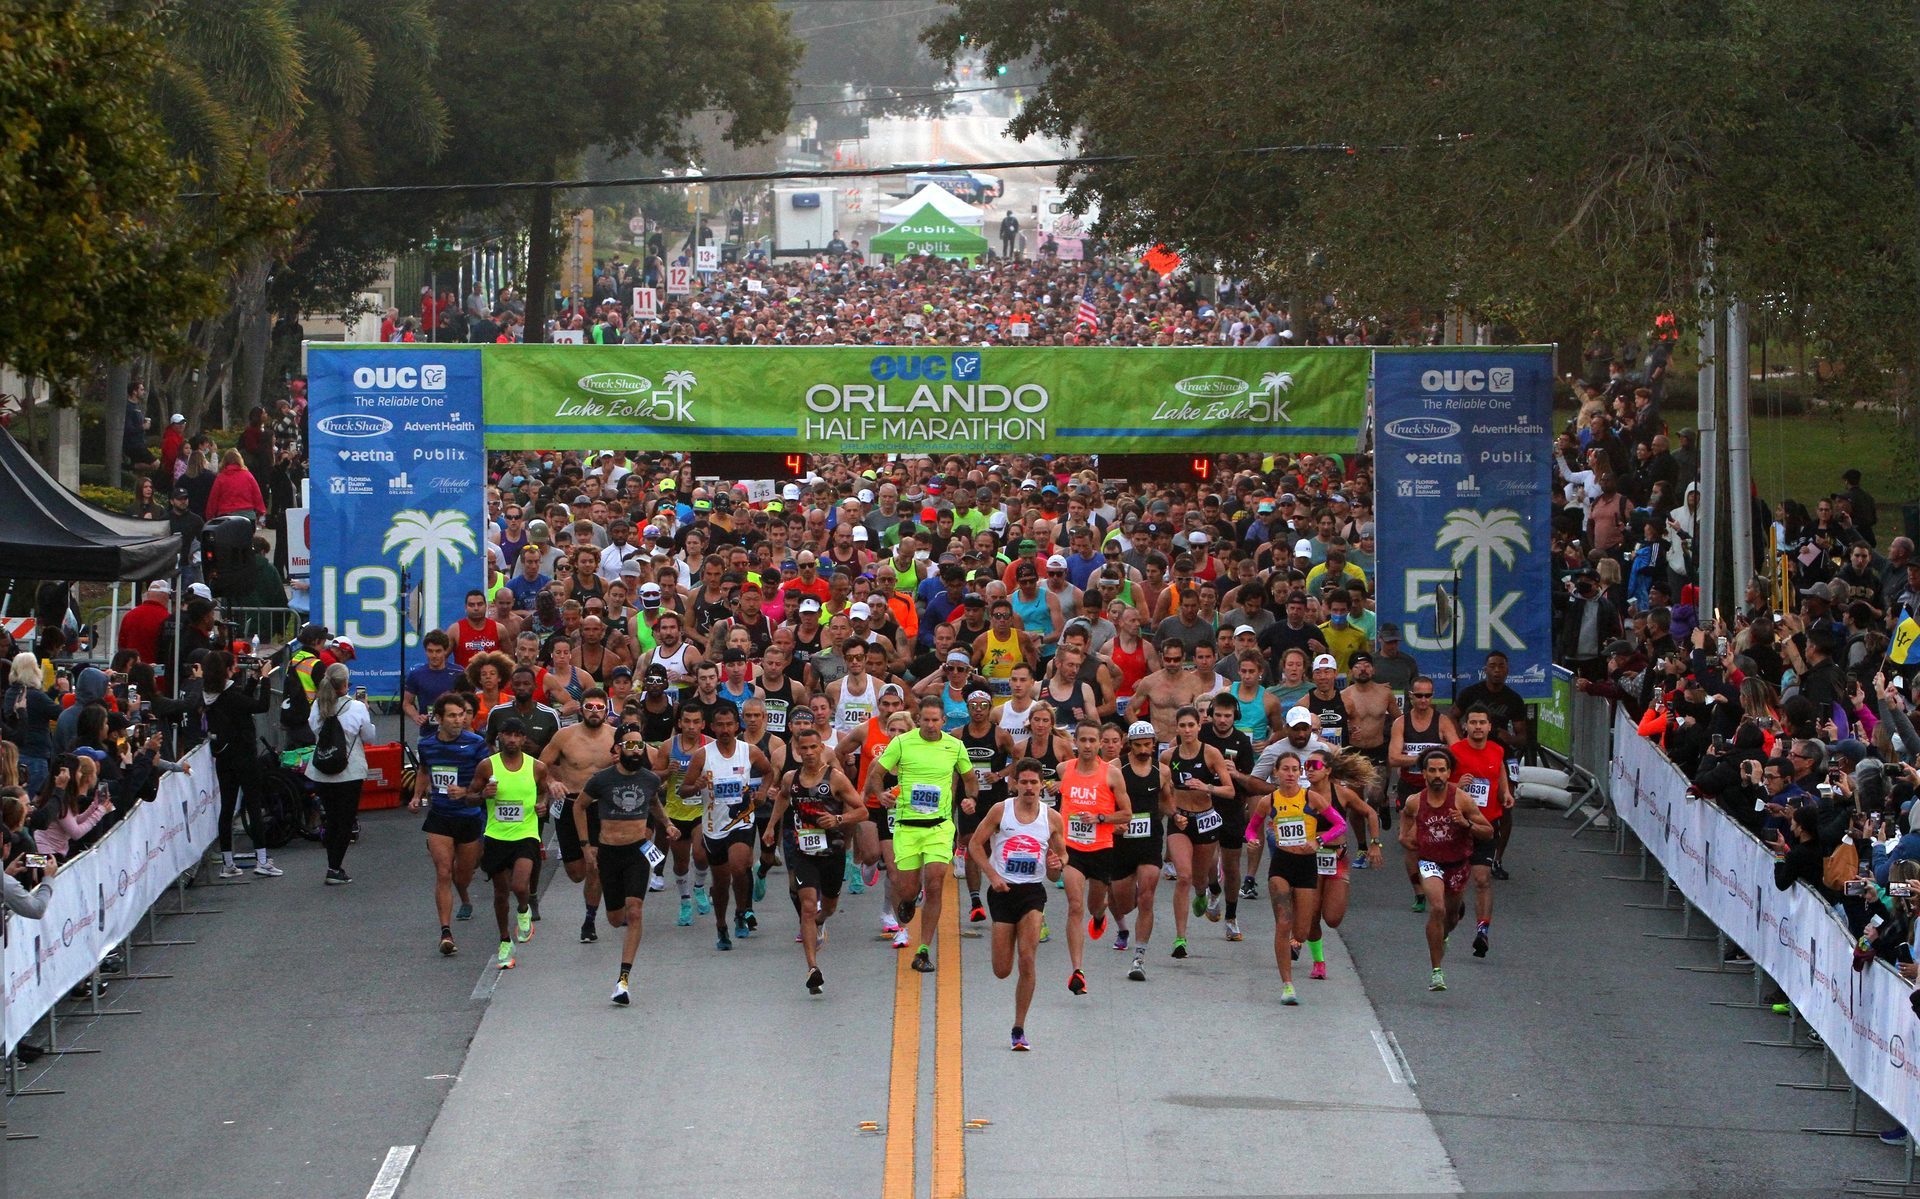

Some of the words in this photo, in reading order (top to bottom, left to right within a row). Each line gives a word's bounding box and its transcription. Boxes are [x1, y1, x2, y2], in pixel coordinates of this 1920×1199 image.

[901, 225, 955, 234] Publix
[906, 242, 950, 252] Publix
[699, 251, 715, 262] 13+
[670, 269, 686, 285] 12
[637, 291, 651, 309] 11
[870, 355, 947, 381] OUC
[353, 366, 418, 389] OUC
[1421, 369, 1485, 392] OUC
[355, 396, 374, 407] The
[377, 396, 419, 407] Reliable
[421, 396, 444, 407] One
[805, 383, 1049, 413] ORLANDO
[1423, 399, 1442, 410] The
[1445, 399, 1487, 410] Reliable
[1489, 399, 1511, 410] One
[555, 398, 602, 418] Lake
[607, 399, 653, 418] Eola
[1152, 401, 1201, 421] Lake
[1202, 402, 1250, 421] Eola
[404, 422, 475, 432] AdventHealth
[806, 418, 876, 441] HALF
[882, 418, 1046, 441] MARATHON
[1472, 424, 1543, 434] AdventHealth
[351, 450, 394, 462] aetna
[1418, 452, 1462, 464] aetna
[786, 455, 800, 475] 4
[1194, 459, 1208, 479] 4
[433, 774, 456, 786] 1792
[716, 782, 740, 794] 5739
[1070, 786, 1097, 800] RUN
[1465, 784, 1487, 795] 3638
[912, 790, 939, 803] 5266
[498, 807, 520, 816] 1322
[1070, 821, 1093, 833] 1362
[1198, 814, 1222, 830] 4204
[1278, 824, 1304, 838] 1878
[803, 835, 820, 847] 788
[1007, 859, 1036, 874] 5788
